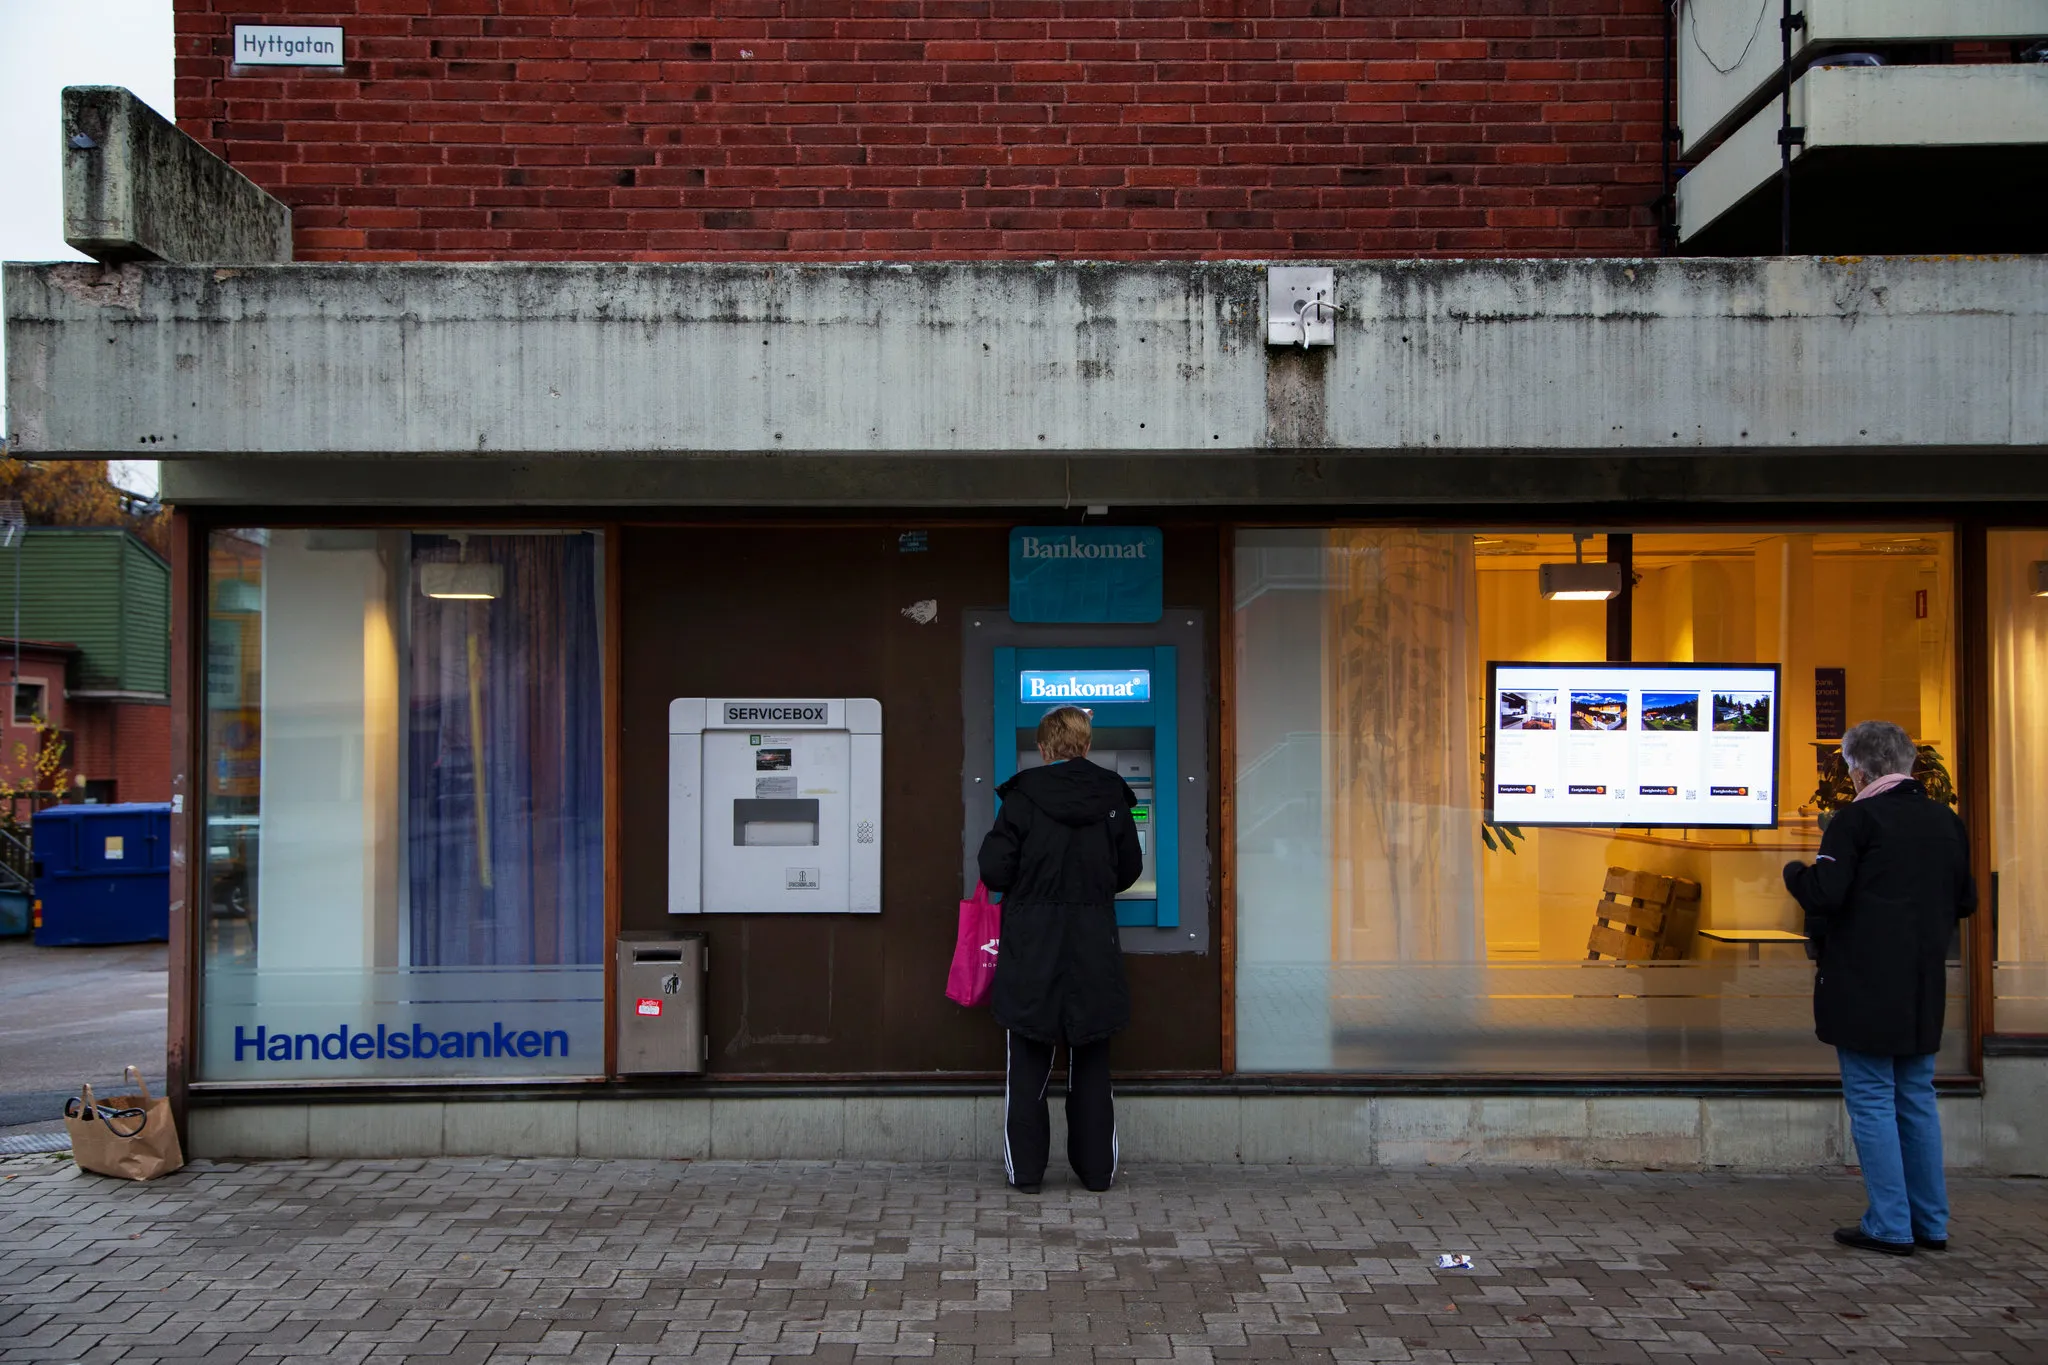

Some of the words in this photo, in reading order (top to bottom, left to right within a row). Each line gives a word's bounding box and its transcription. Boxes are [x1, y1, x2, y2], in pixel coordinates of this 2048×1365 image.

[243, 34, 334, 57] Hyttgatan
[728, 707, 824, 721] SERVICEBOX
[234, 1021, 570, 1062] Handelsbanken
